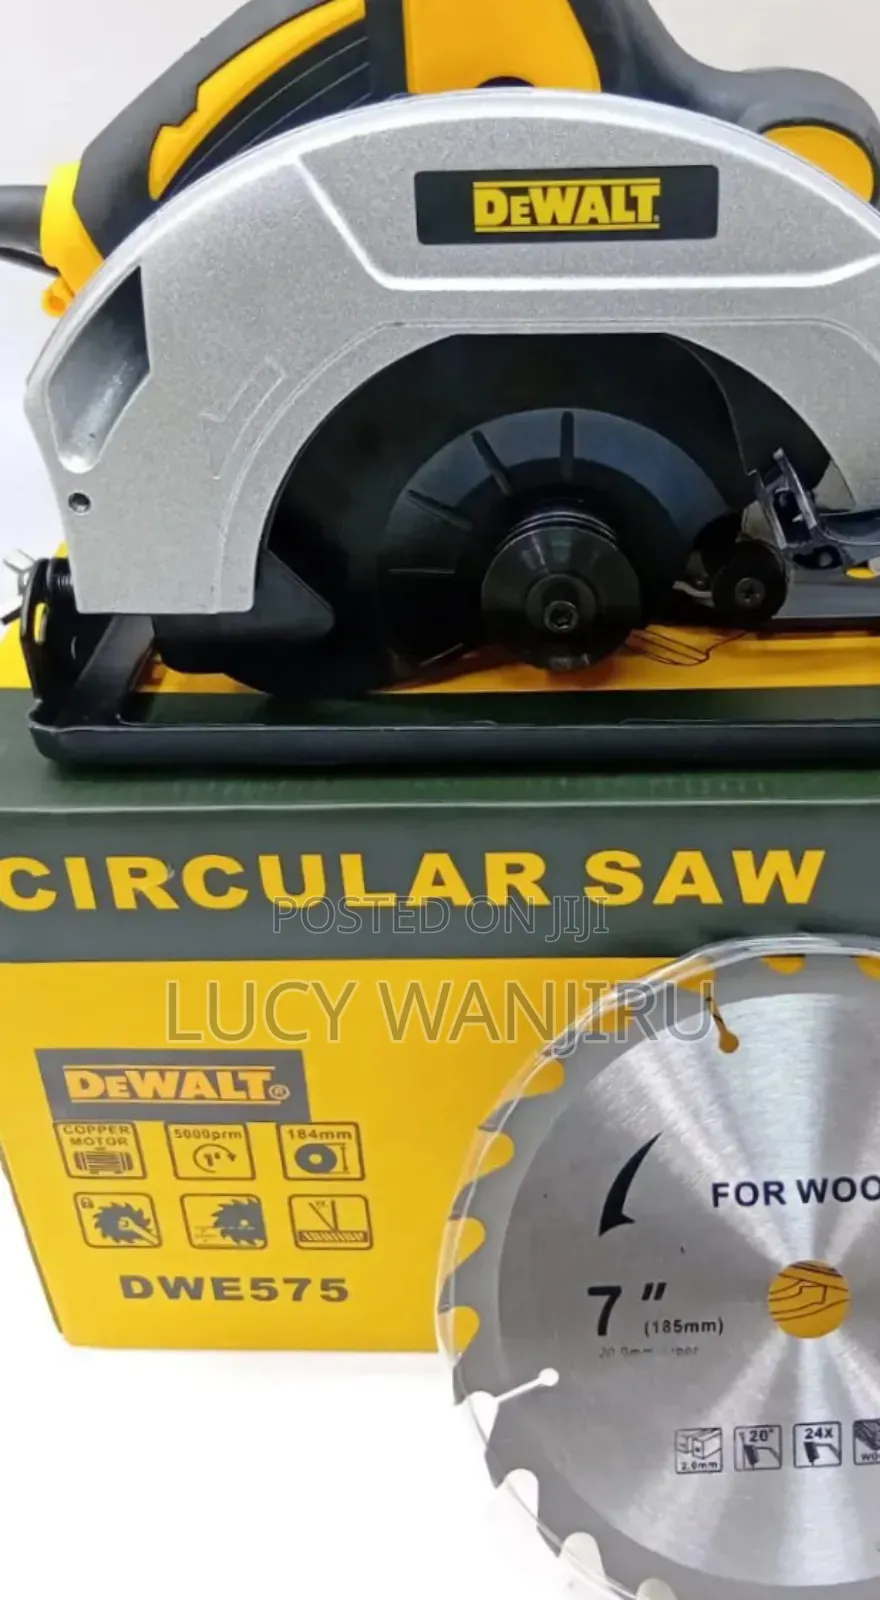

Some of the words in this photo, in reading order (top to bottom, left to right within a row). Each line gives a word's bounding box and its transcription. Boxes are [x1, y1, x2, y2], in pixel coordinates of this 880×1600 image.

[0, 852, 551, 912] CIRCULAR
[584, 849, 825, 906] SAW
[63, 1124, 130, 1136] COPPER
[174, 1128, 243, 1141] 5000prm
[287, 1128, 353, 1140] 184mm
[70, 1136, 129, 1147] MOTOR
[711, 1180, 786, 1208] FOR
[796, 1175, 880, 1204] WOO
[119, 1274, 349, 1303] DWE575
[644, 1318, 724, 1337] (185mm)
[805, 1427, 833, 1440] 24X
